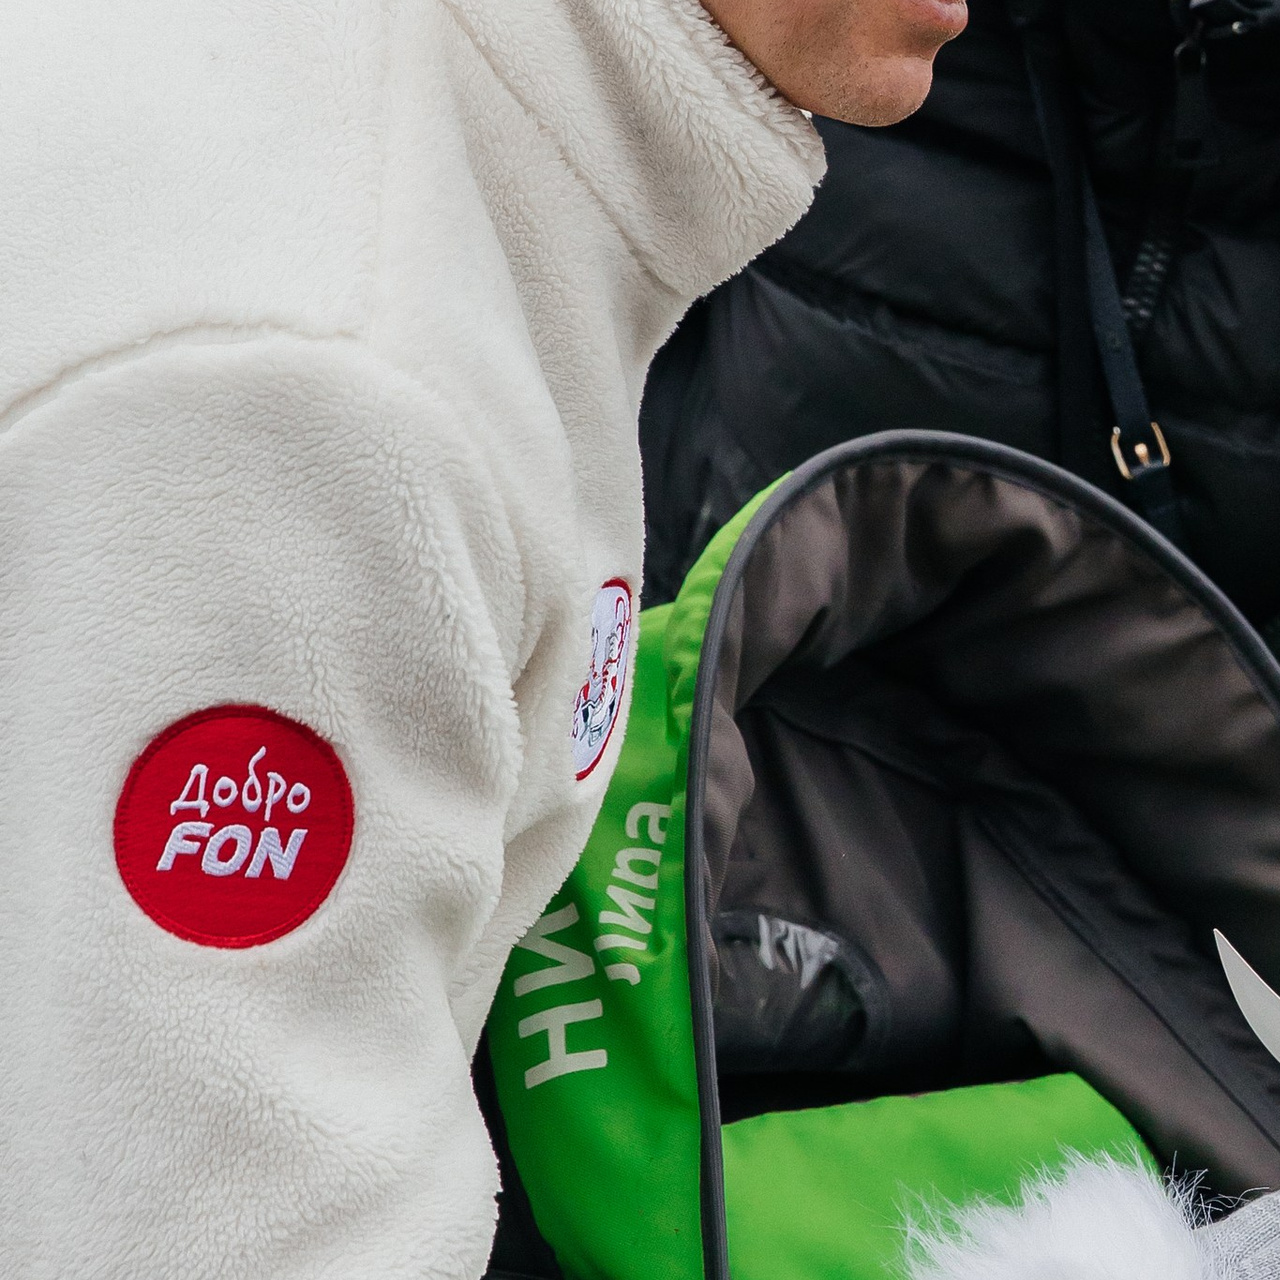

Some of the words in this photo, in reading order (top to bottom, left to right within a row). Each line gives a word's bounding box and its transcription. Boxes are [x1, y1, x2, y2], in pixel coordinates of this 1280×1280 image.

[170, 745, 311, 822] Добро
[156, 821, 308, 881] FON
[513, 902, 608, 1090] НИ
